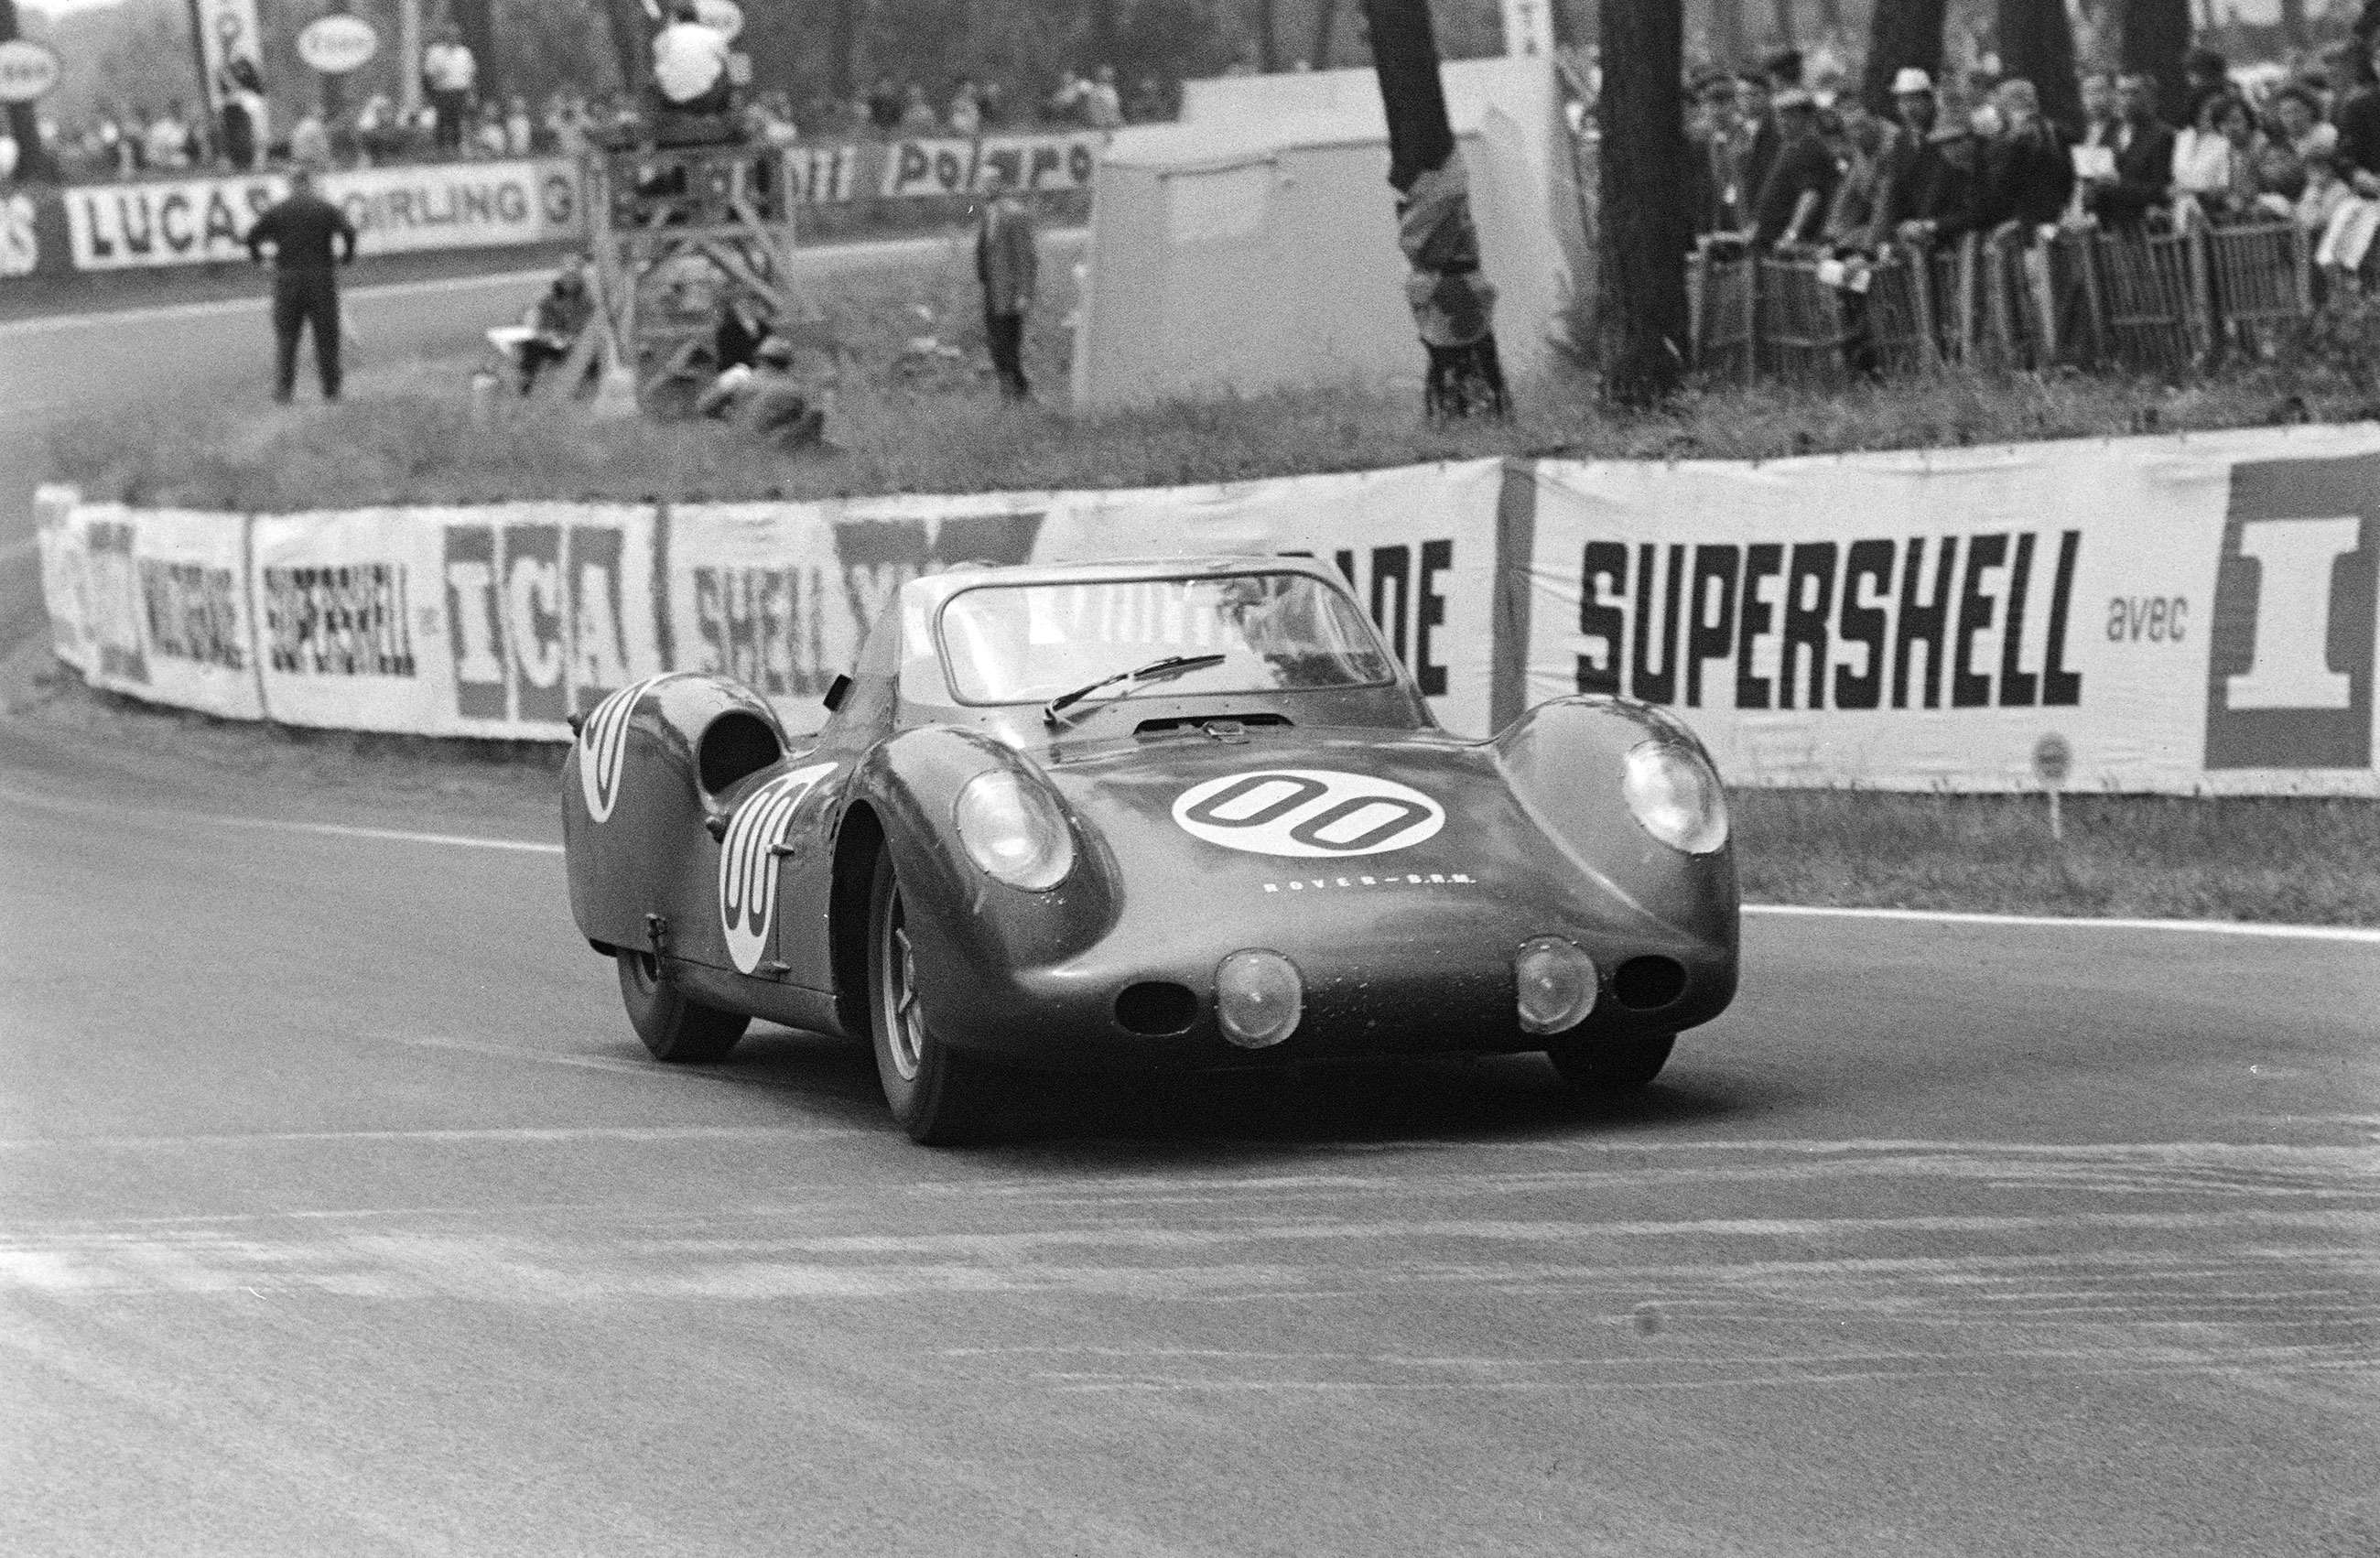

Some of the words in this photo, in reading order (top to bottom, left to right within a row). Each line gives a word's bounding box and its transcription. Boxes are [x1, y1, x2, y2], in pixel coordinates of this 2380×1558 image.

[1576, 530, 2082, 709] SUPERSHELL
[2106, 596, 2188, 642] avec
[1185, 774, 1433, 850] 00
